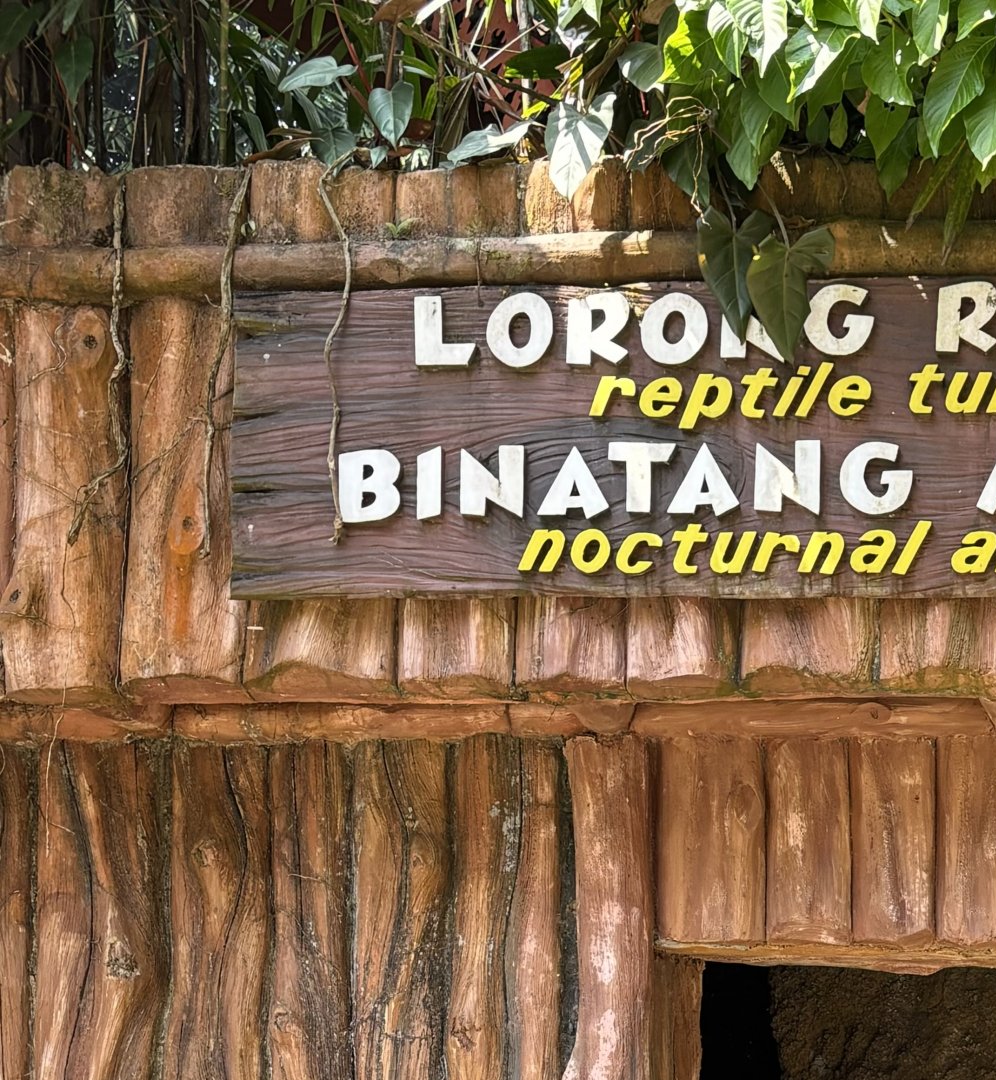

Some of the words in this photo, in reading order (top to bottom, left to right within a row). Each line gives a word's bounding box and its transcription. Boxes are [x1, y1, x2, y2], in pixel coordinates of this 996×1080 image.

[589, 362, 872, 429] reptile
[338, 440, 913, 523] BINATANG
[518, 521, 932, 574] nocturnal
